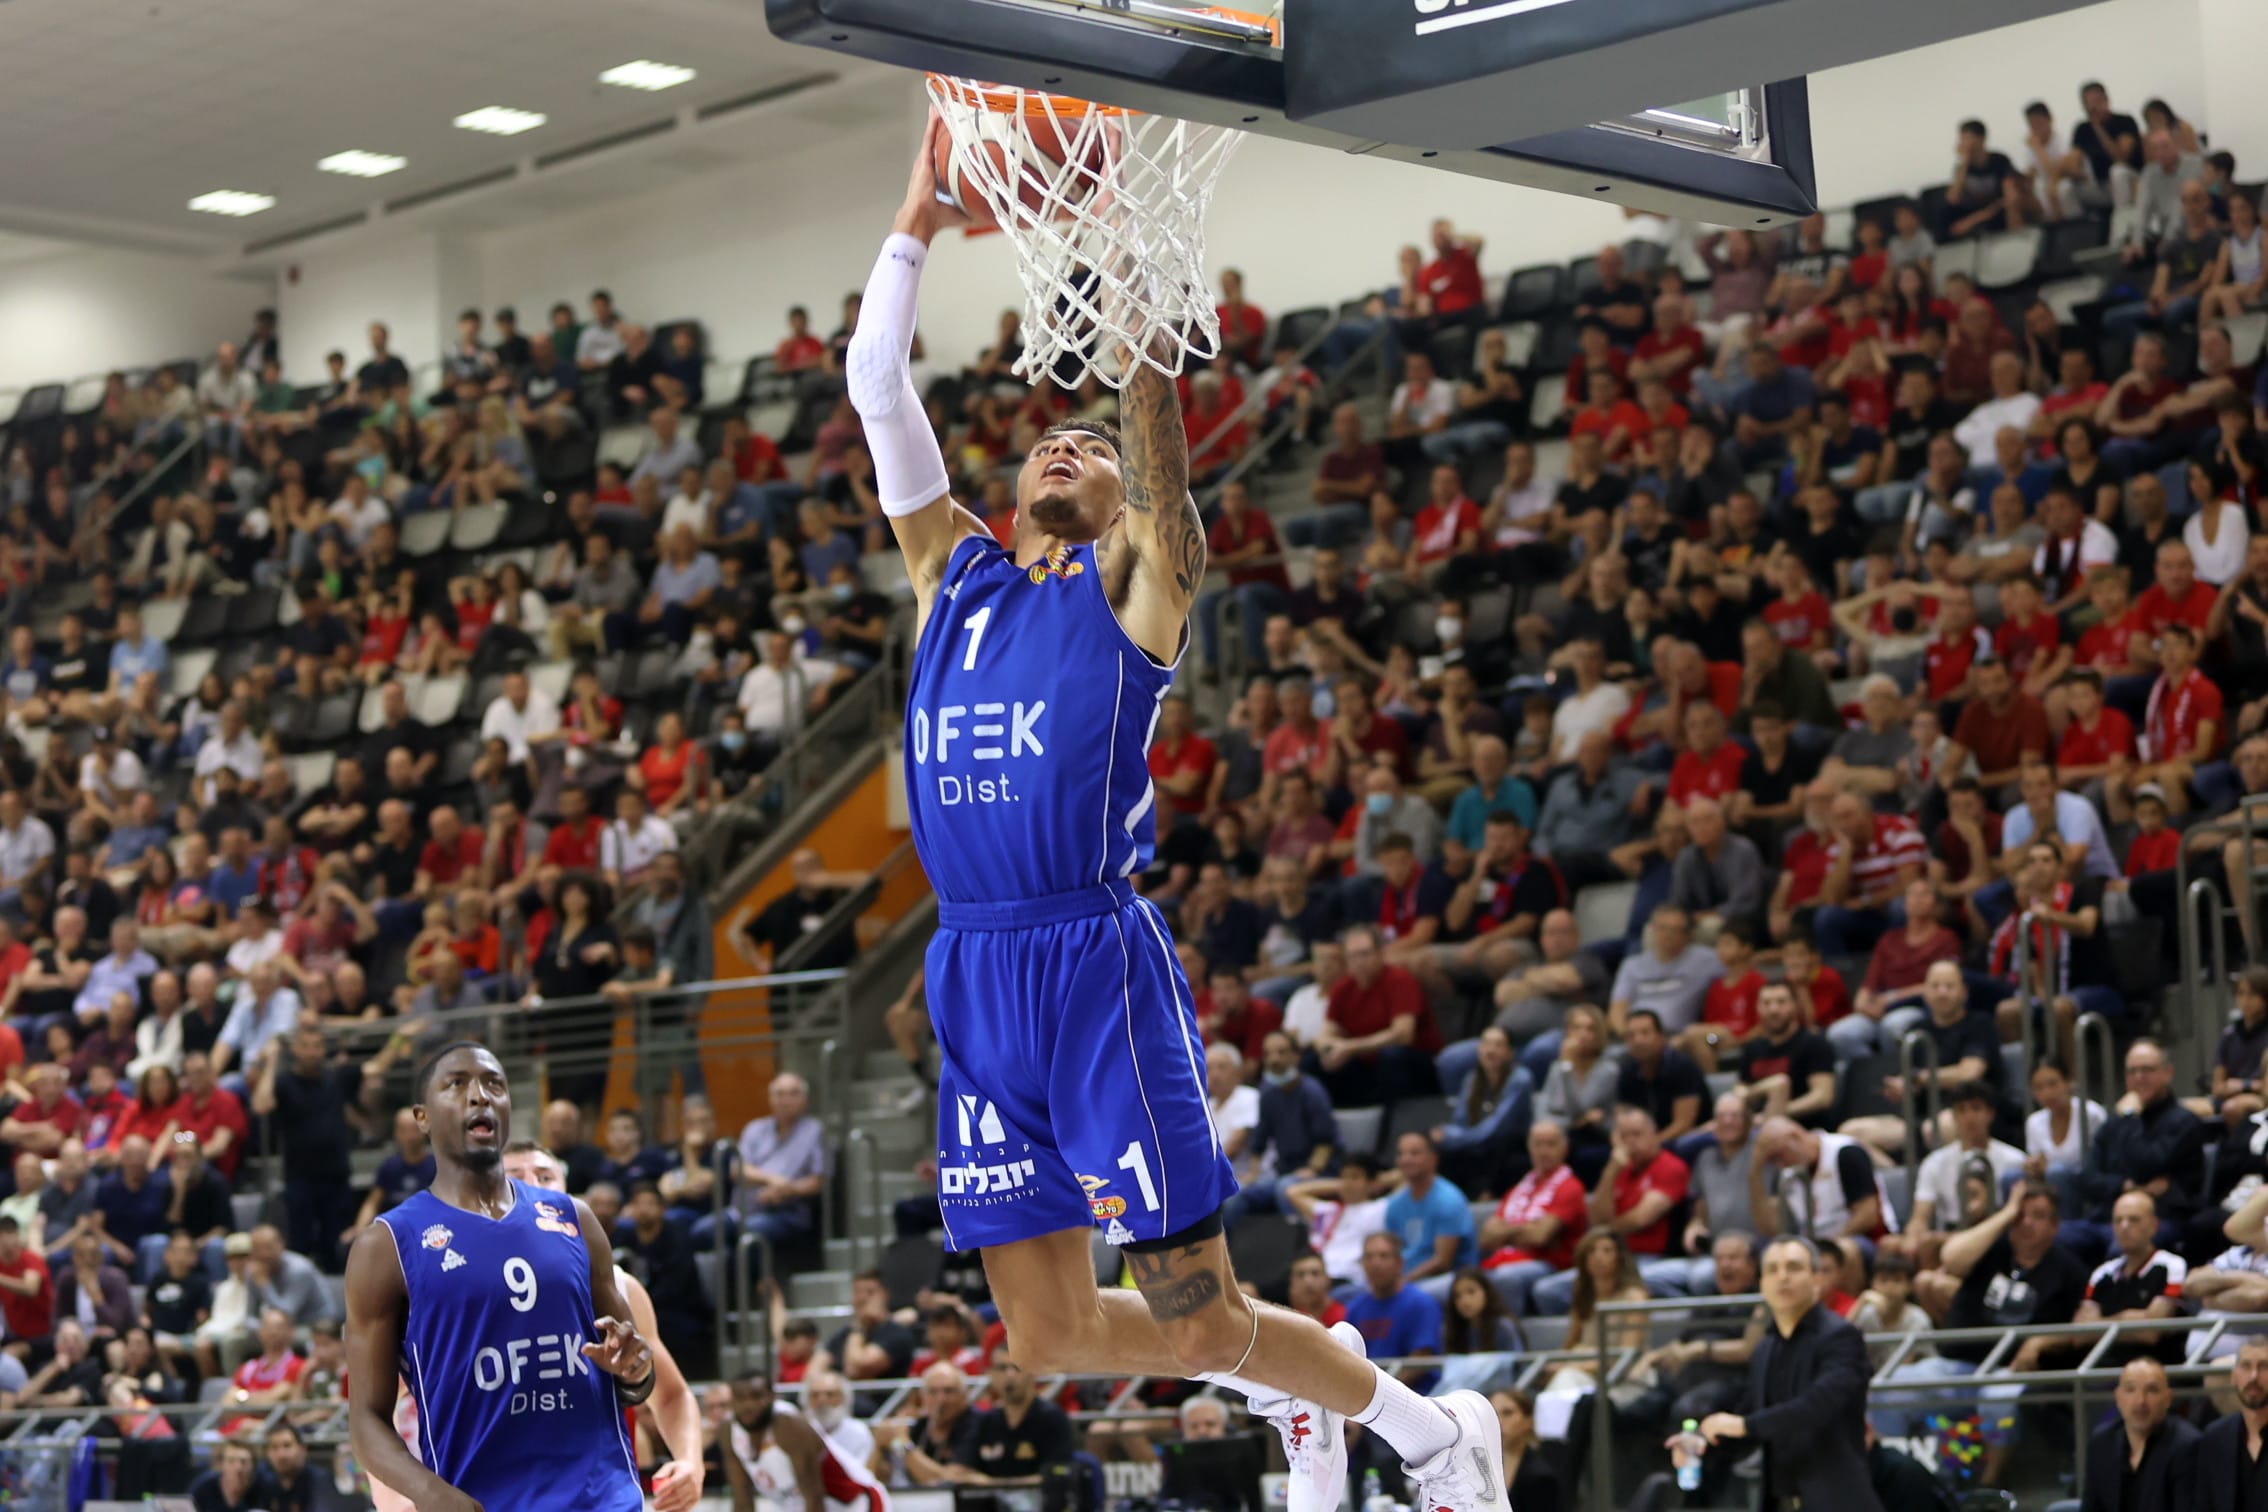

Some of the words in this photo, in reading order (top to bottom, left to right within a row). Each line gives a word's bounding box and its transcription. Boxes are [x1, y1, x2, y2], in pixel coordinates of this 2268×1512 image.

[963, 607, 991, 671] 1
[913, 700, 1046, 766] OFEK
[938, 773, 1020, 807] Dist.
[941, 1159, 1035, 1195] יובלים
[1117, 1140, 1160, 1212] 1
[503, 1257, 538, 1312] 9
[473, 1332, 589, 1392] OFEK
[510, 1387, 574, 1416] Dist.
